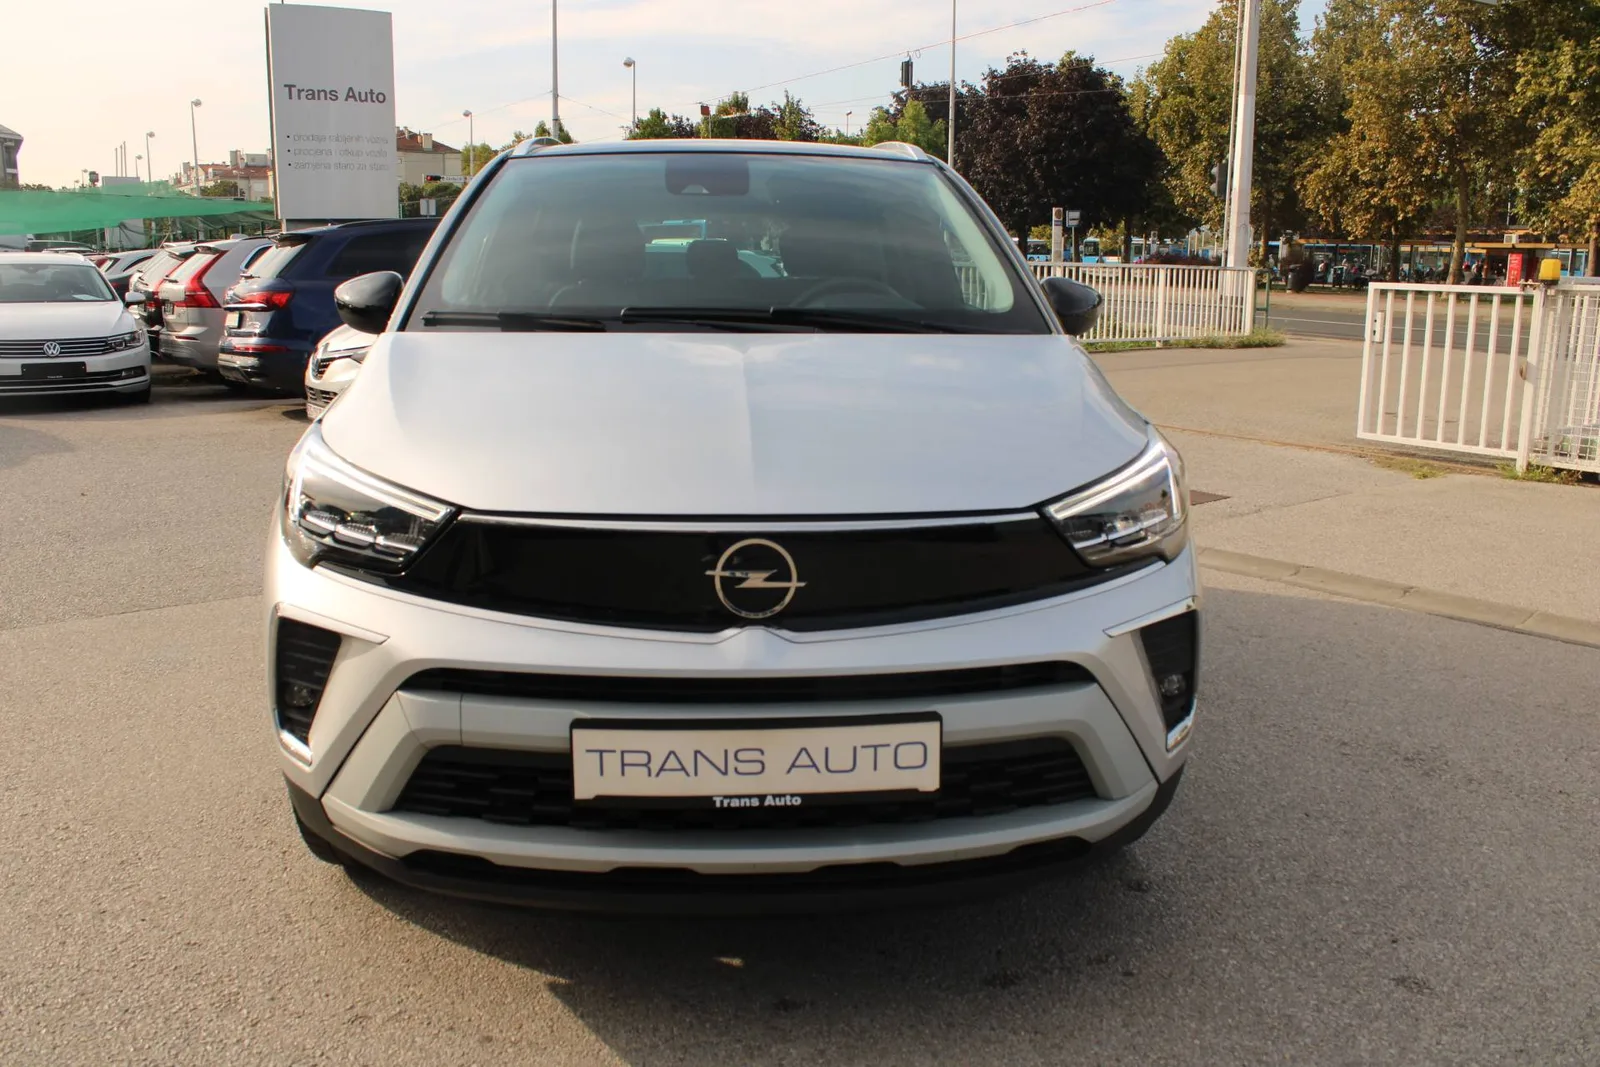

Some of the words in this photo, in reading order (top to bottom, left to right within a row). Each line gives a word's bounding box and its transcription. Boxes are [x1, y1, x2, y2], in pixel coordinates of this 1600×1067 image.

[283, 84, 339, 101] Trans
[344, 86, 387, 104] Auto
[293, 133, 326, 144] prodaja
[339, 148, 363, 158] otkup
[294, 160, 331, 171] zamjena
[334, 161, 355, 170] staro
[356, 162, 367, 171] za
[585, 748, 766, 777] TRANS
[786, 741, 928, 775] AUTO
[713, 796, 760, 808] Trans
[763, 794, 802, 807] Auto
